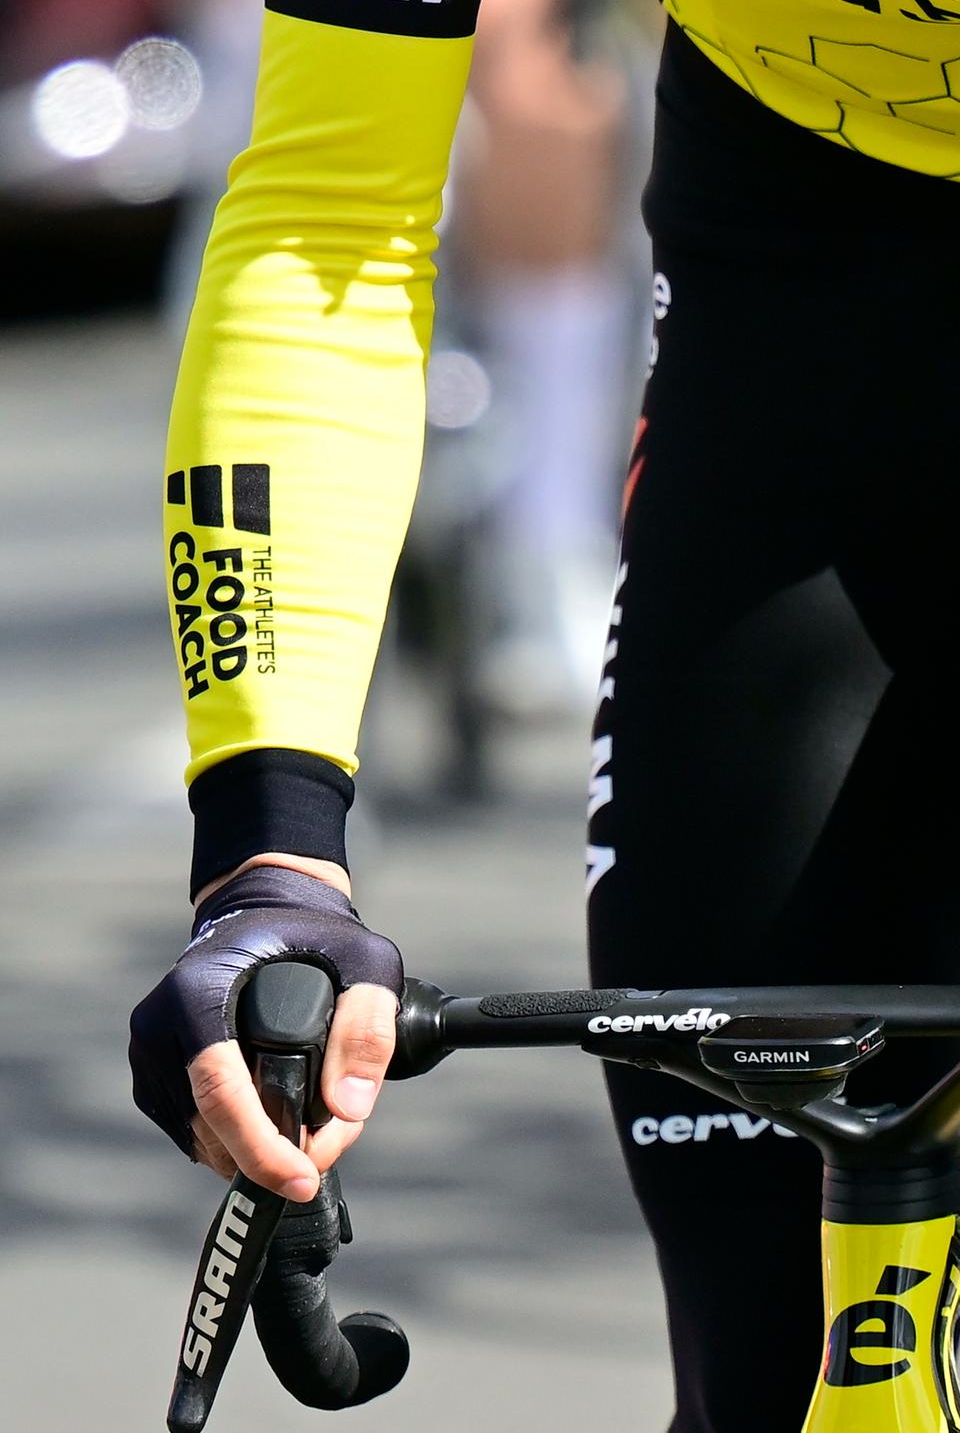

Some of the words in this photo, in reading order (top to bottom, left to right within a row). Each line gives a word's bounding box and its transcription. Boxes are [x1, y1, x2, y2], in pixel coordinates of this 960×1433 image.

[252, 546, 272, 582] THE
[170, 532, 209, 700] COACH
[203, 548, 247, 681] FOOD
[254, 586, 276, 674] ATHLETE'S
[734, 1051, 810, 1063] GARMIN
[631, 1113, 799, 1146] cerv
[183, 1190, 256, 1378] SRAM
